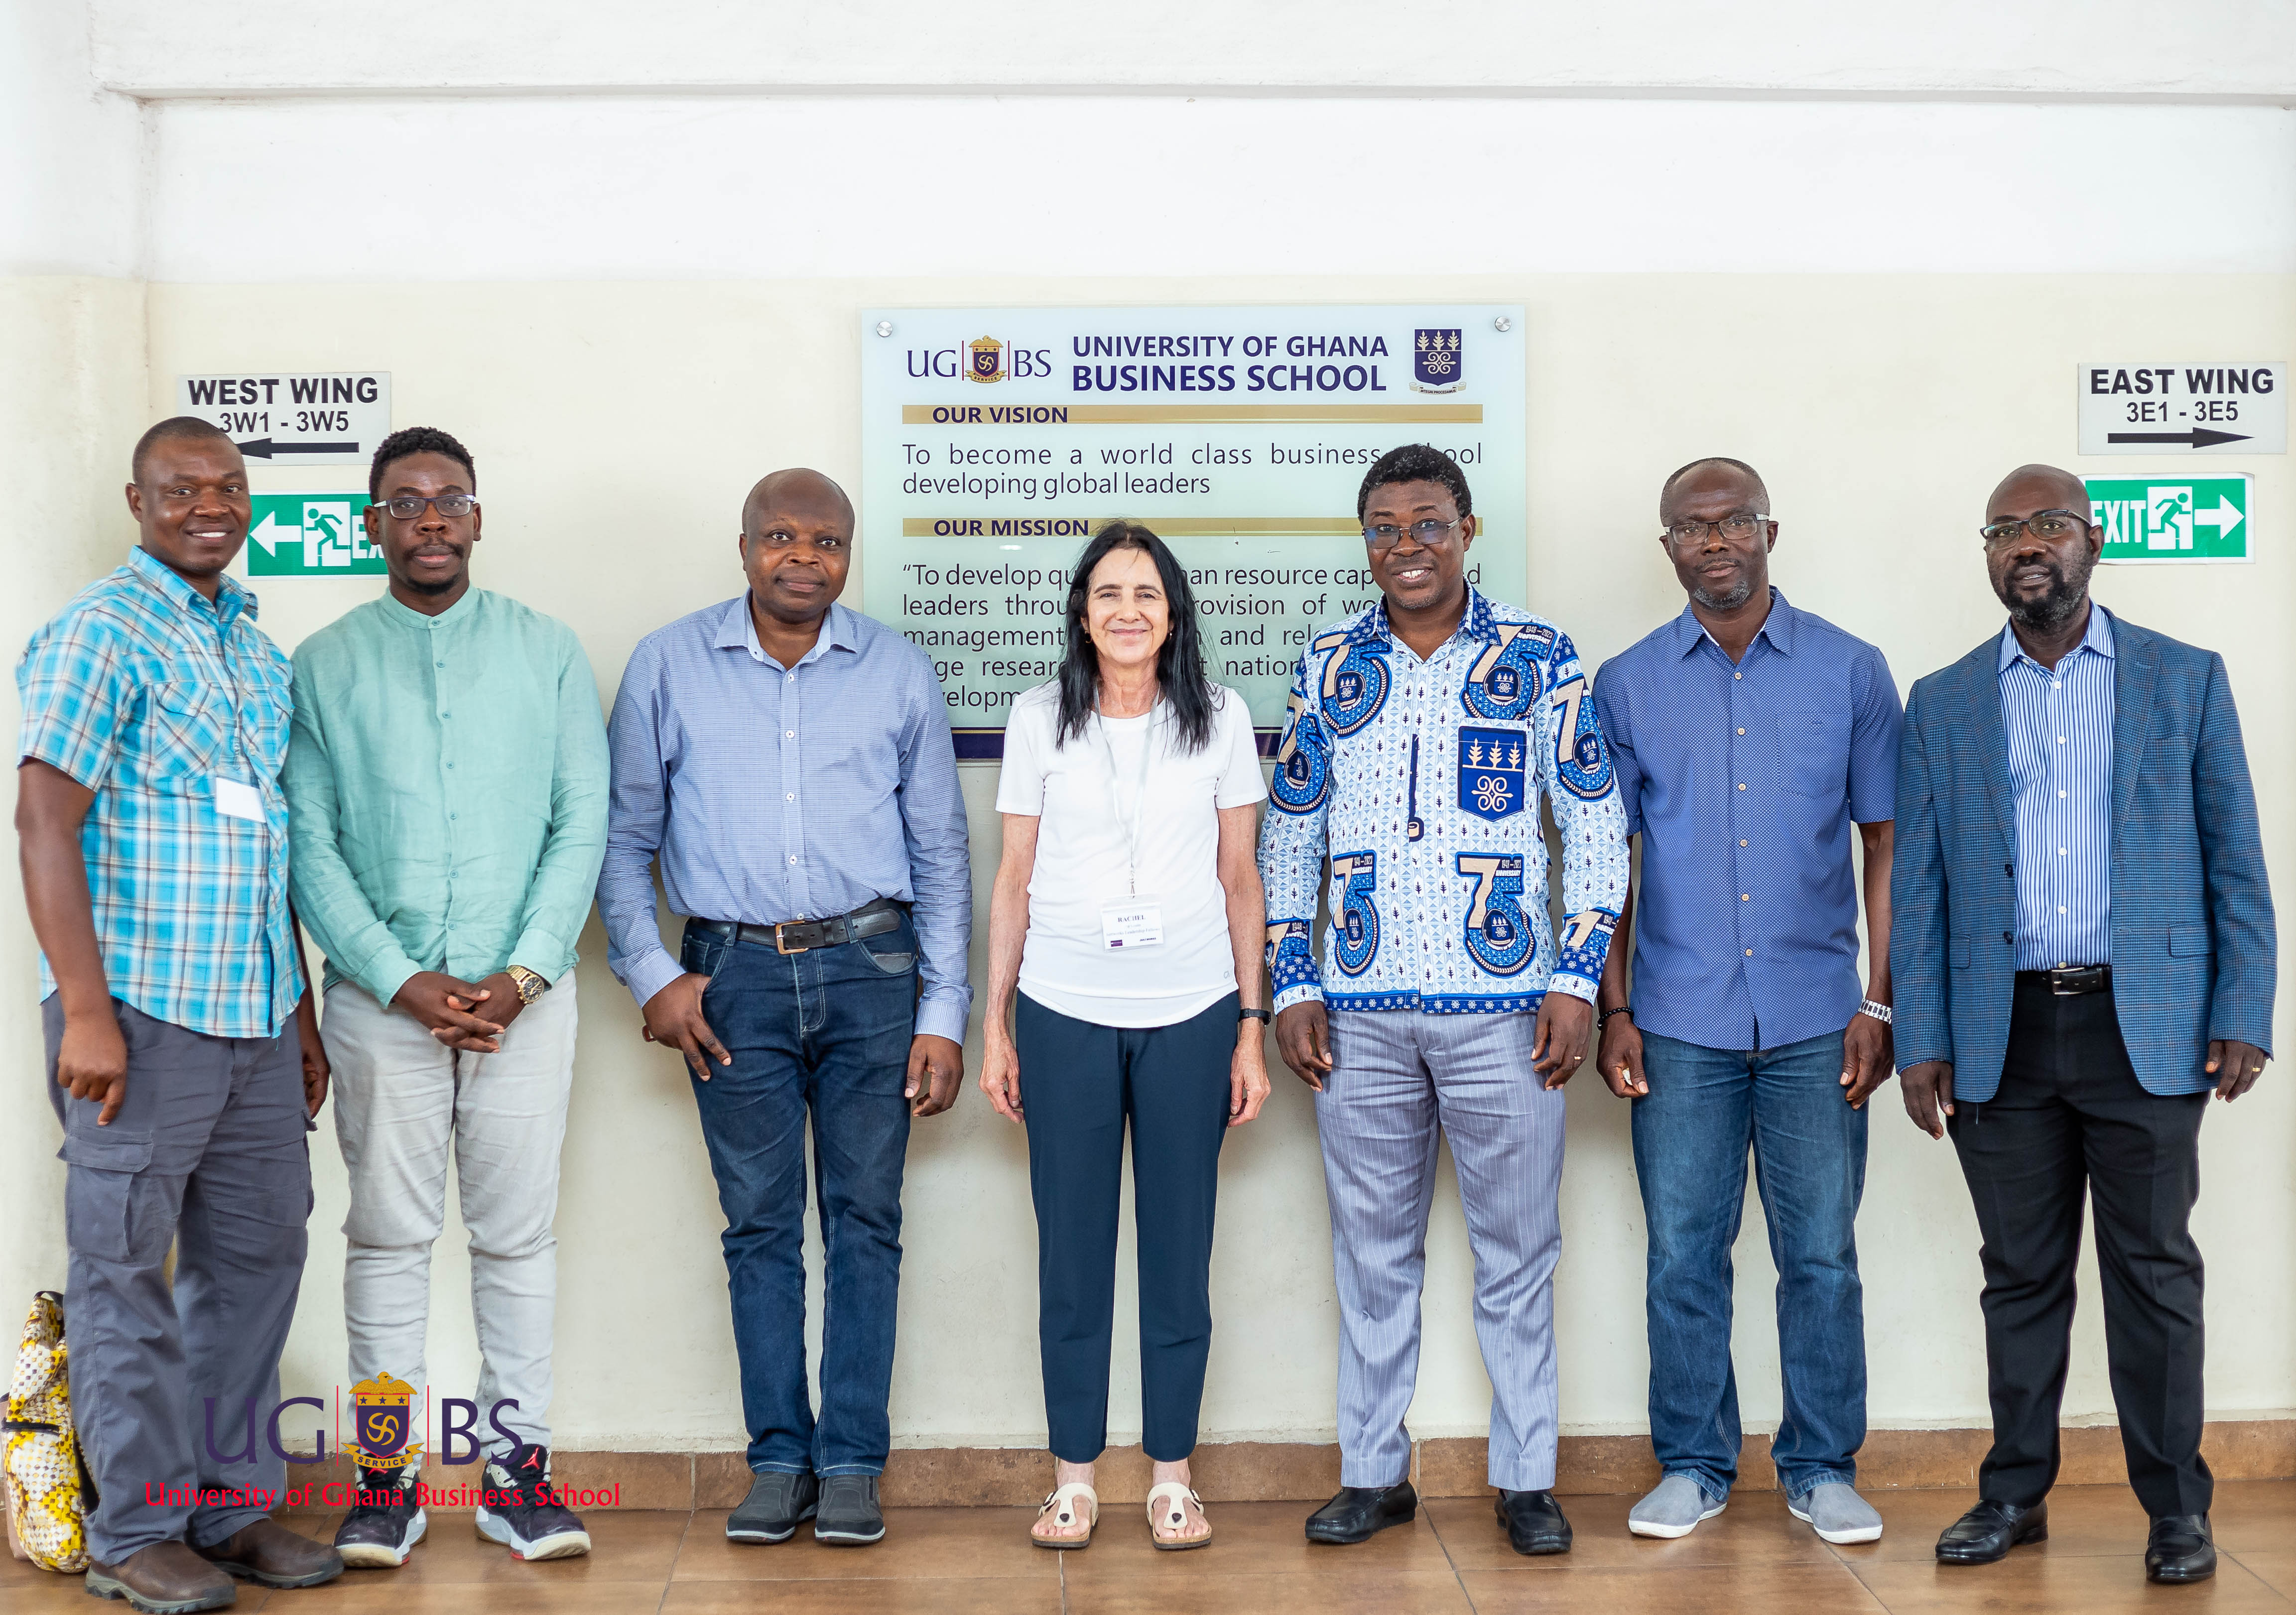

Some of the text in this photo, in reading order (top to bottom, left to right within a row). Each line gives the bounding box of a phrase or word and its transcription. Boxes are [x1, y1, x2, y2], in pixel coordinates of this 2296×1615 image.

[1074, 336, 1389, 357] UNIVERSITY OF GHANA
[908, 350, 1051, 377] UG BS
[1073, 365, 1386, 391] BUSINESS SCHOOL
[2091, 369, 2273, 394] EAST WING
[188, 377, 377, 405] WEST WING
[220, 412, 268, 433] 3W1
[297, 411, 348, 431] 3W5
[933, 407, 1067, 423] OUR VISION
[2127, 402, 2167, 422] 3E1
[2195, 401, 2238, 421] 3E5
[902, 445, 930, 464] To
[951, 443, 1051, 464] become
[1071, 450, 1081, 464] a
[1101, 443, 1171, 464] world
[1192, 443, 1251, 464] class
[1272, 443, 1380, 464] business
[903, 472, 1209, 499] developing global leaders
[934, 520, 1088, 535] OUR MISSION
[903, 565, 939, 585] “To
[946, 564, 1041, 591] develop
[1226, 570, 1327, 584] resource
[904, 594, 988, 615] leaders
[1005, 594, 1068, 616] throu
[1195, 594, 1284, 615] ovision
[1303, 594, 1327, 615] of
[904, 626, 1065, 652] management
[1221, 624, 1264, 645] and
[1517, 632, 1551, 644] ANNIVERSARY
[982, 660, 1062, 677] resear
[1226, 655, 1298, 676] nation
